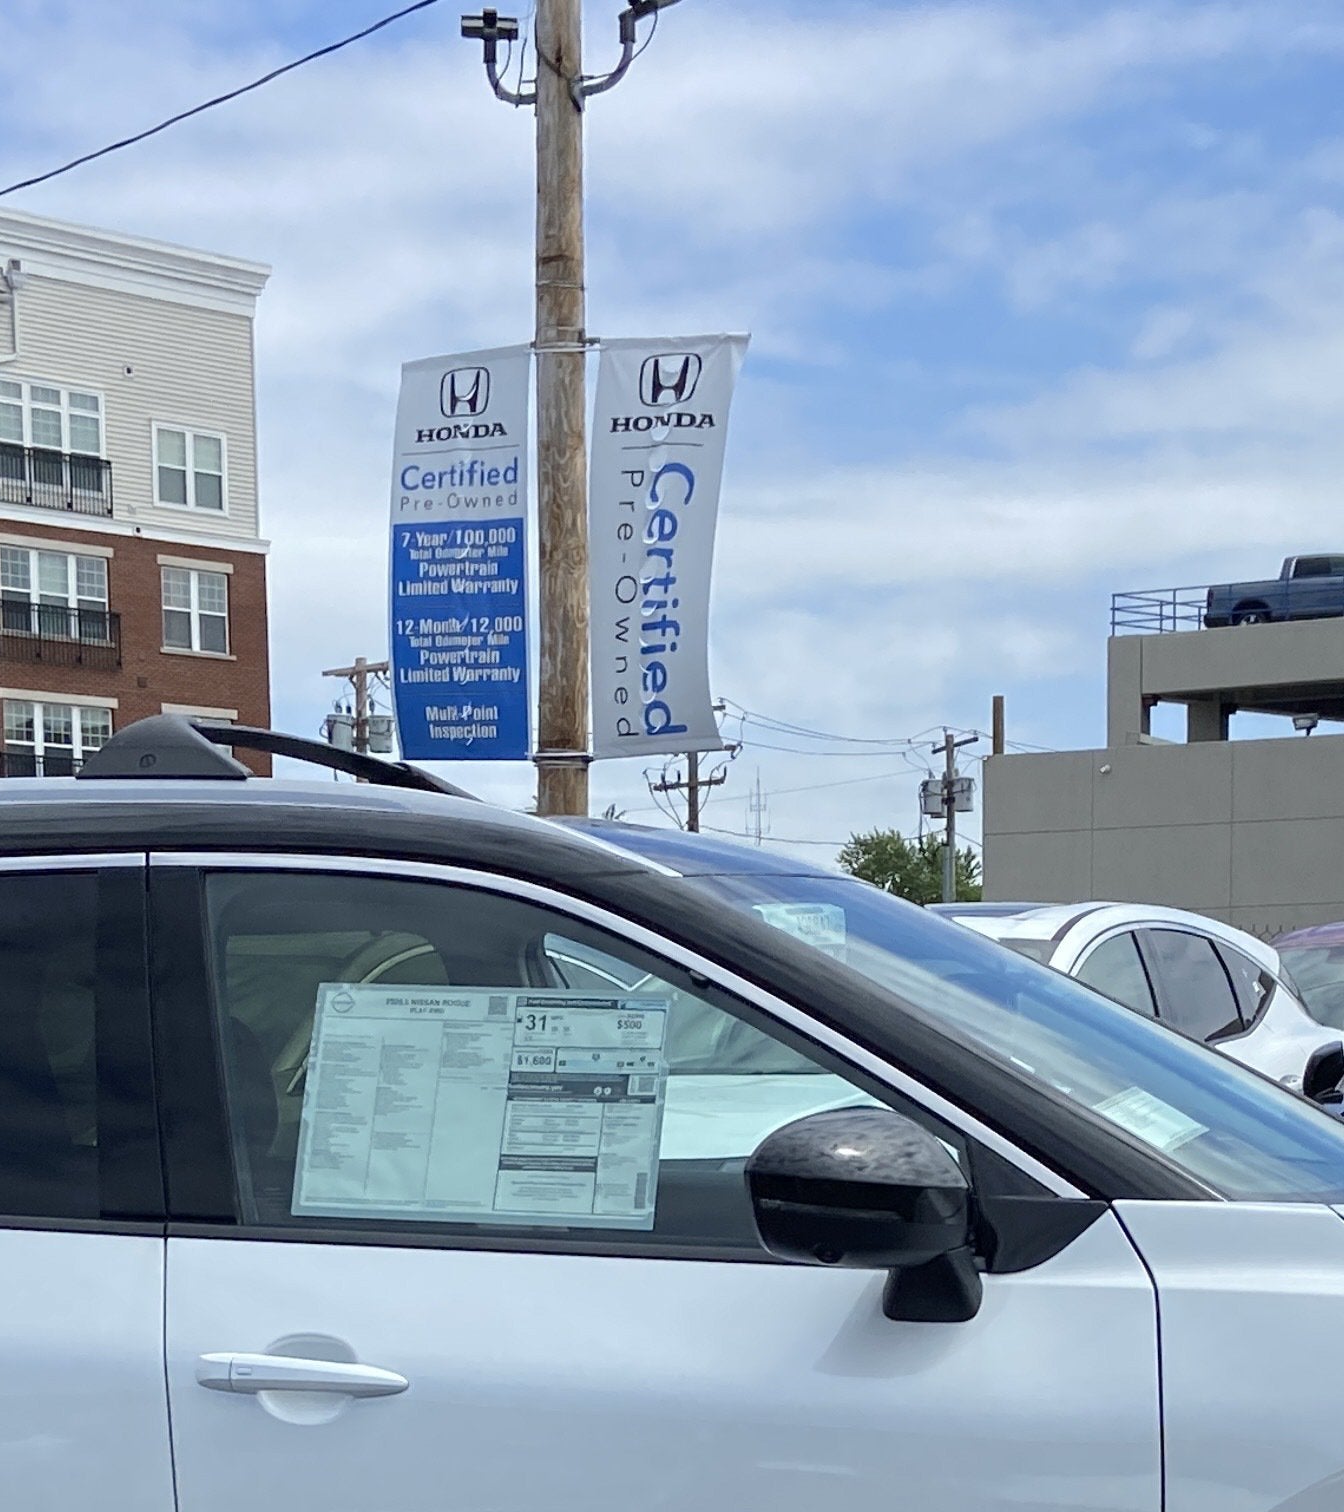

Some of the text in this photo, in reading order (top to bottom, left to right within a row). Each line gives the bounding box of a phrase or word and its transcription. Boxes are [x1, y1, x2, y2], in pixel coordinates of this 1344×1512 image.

[609, 412, 716, 433] HONDA
[415, 422, 508, 444] HONDA
[400, 457, 518, 491] Certified
[400, 487, 518, 511] Pre-Owned
[419, 560, 498, 578] Powertrain
[398, 578, 519, 596] Limited Warranty
[614, 470, 645, 737] Pre-Owned
[640, 462, 695, 736] Certified
[420, 648, 500, 666] Powertrain
[400, 666, 521, 683] Limited Warranty
[429, 723, 497, 741] Inspection
[525, 1014, 548, 1032] 31
